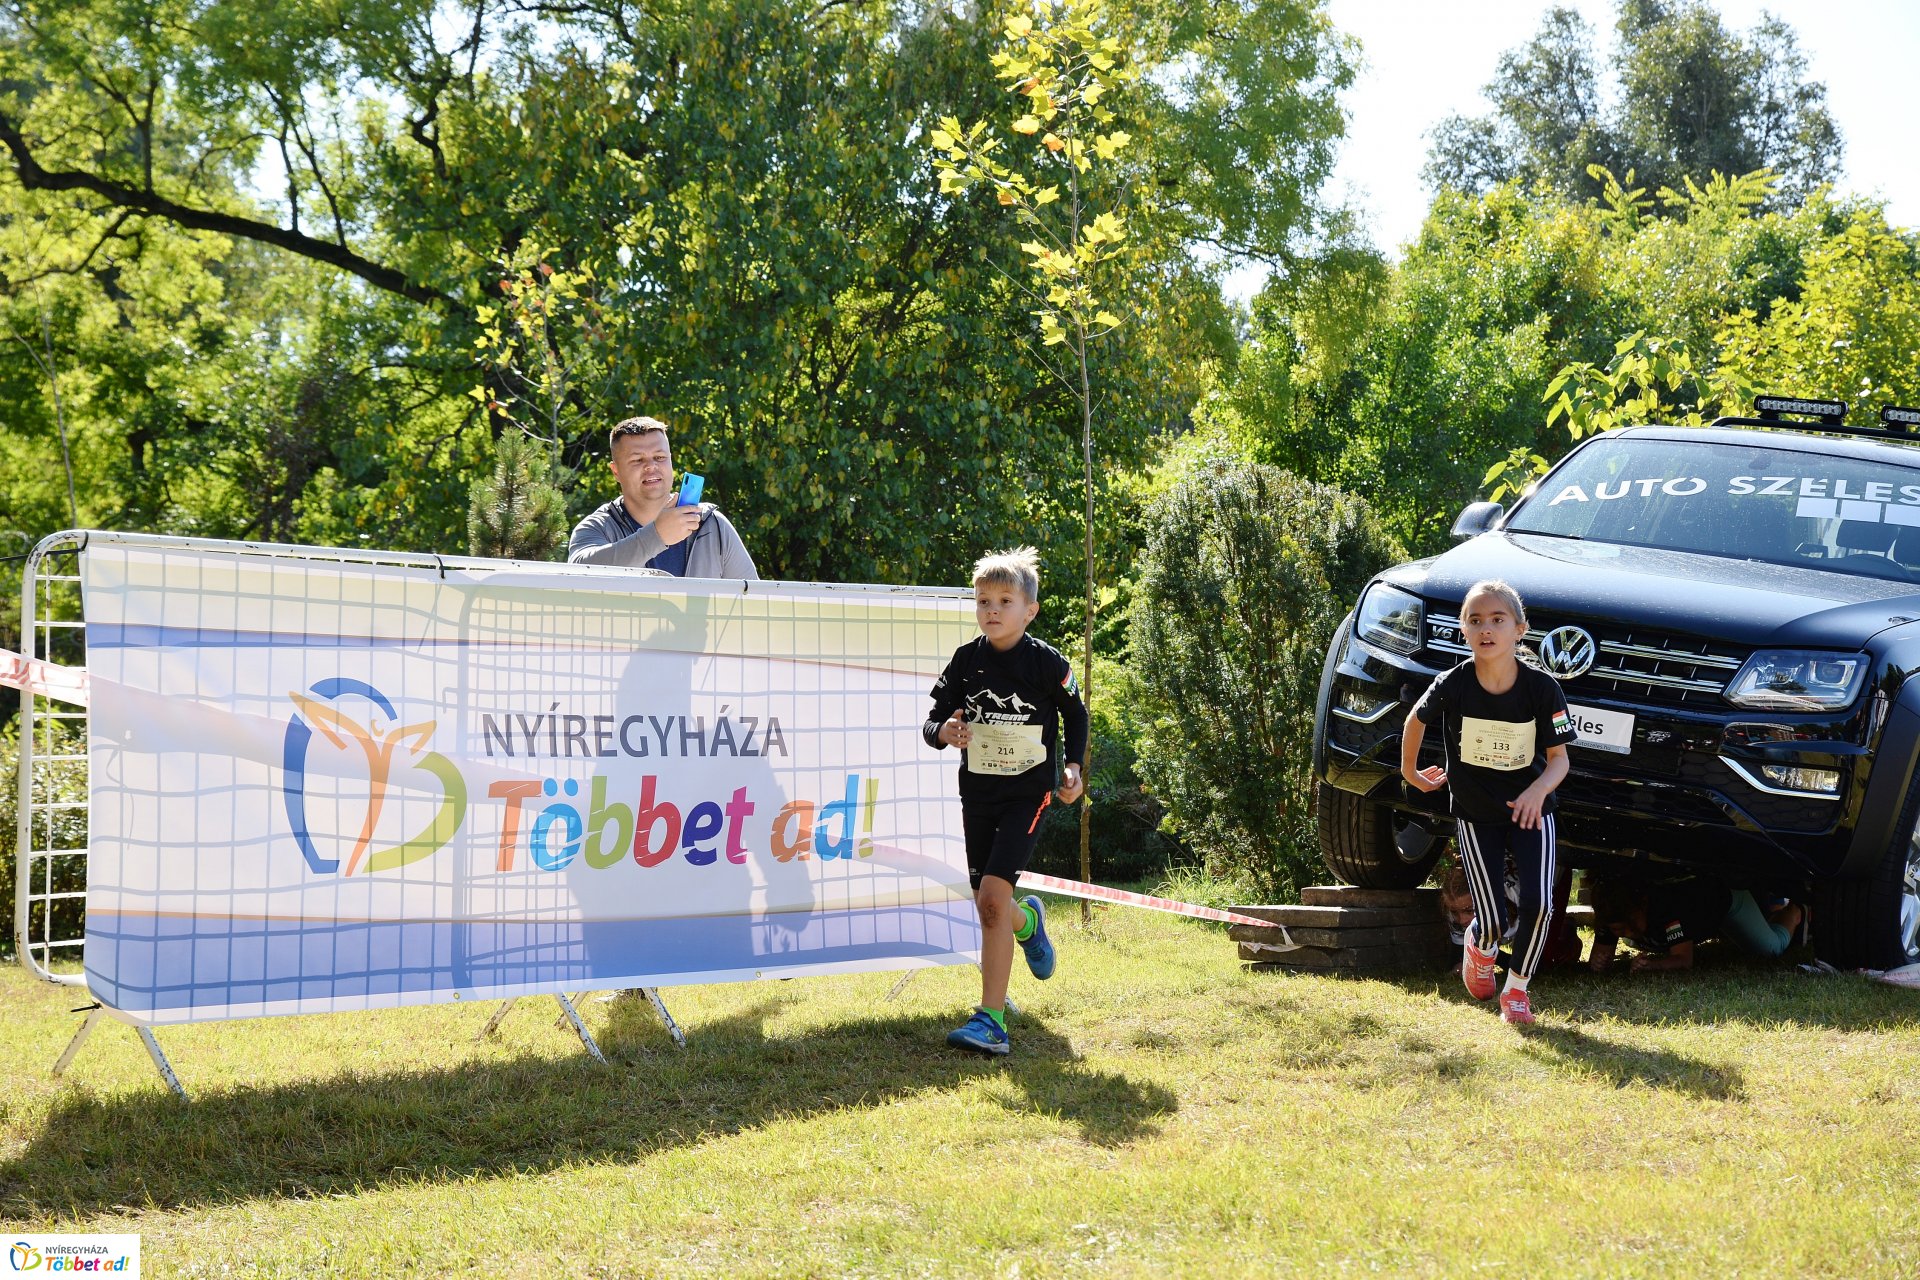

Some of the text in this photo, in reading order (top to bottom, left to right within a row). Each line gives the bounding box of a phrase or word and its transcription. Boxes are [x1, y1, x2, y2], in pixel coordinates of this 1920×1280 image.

[1432, 625, 1454, 639] V6
[482, 702, 788, 758] NYÍREGYHÁZA
[998, 747, 1014, 755] 214
[1492, 742, 1510, 751] 133
[488, 774, 880, 872] Többet ad!
[1667, 931, 1684, 942] HUN
